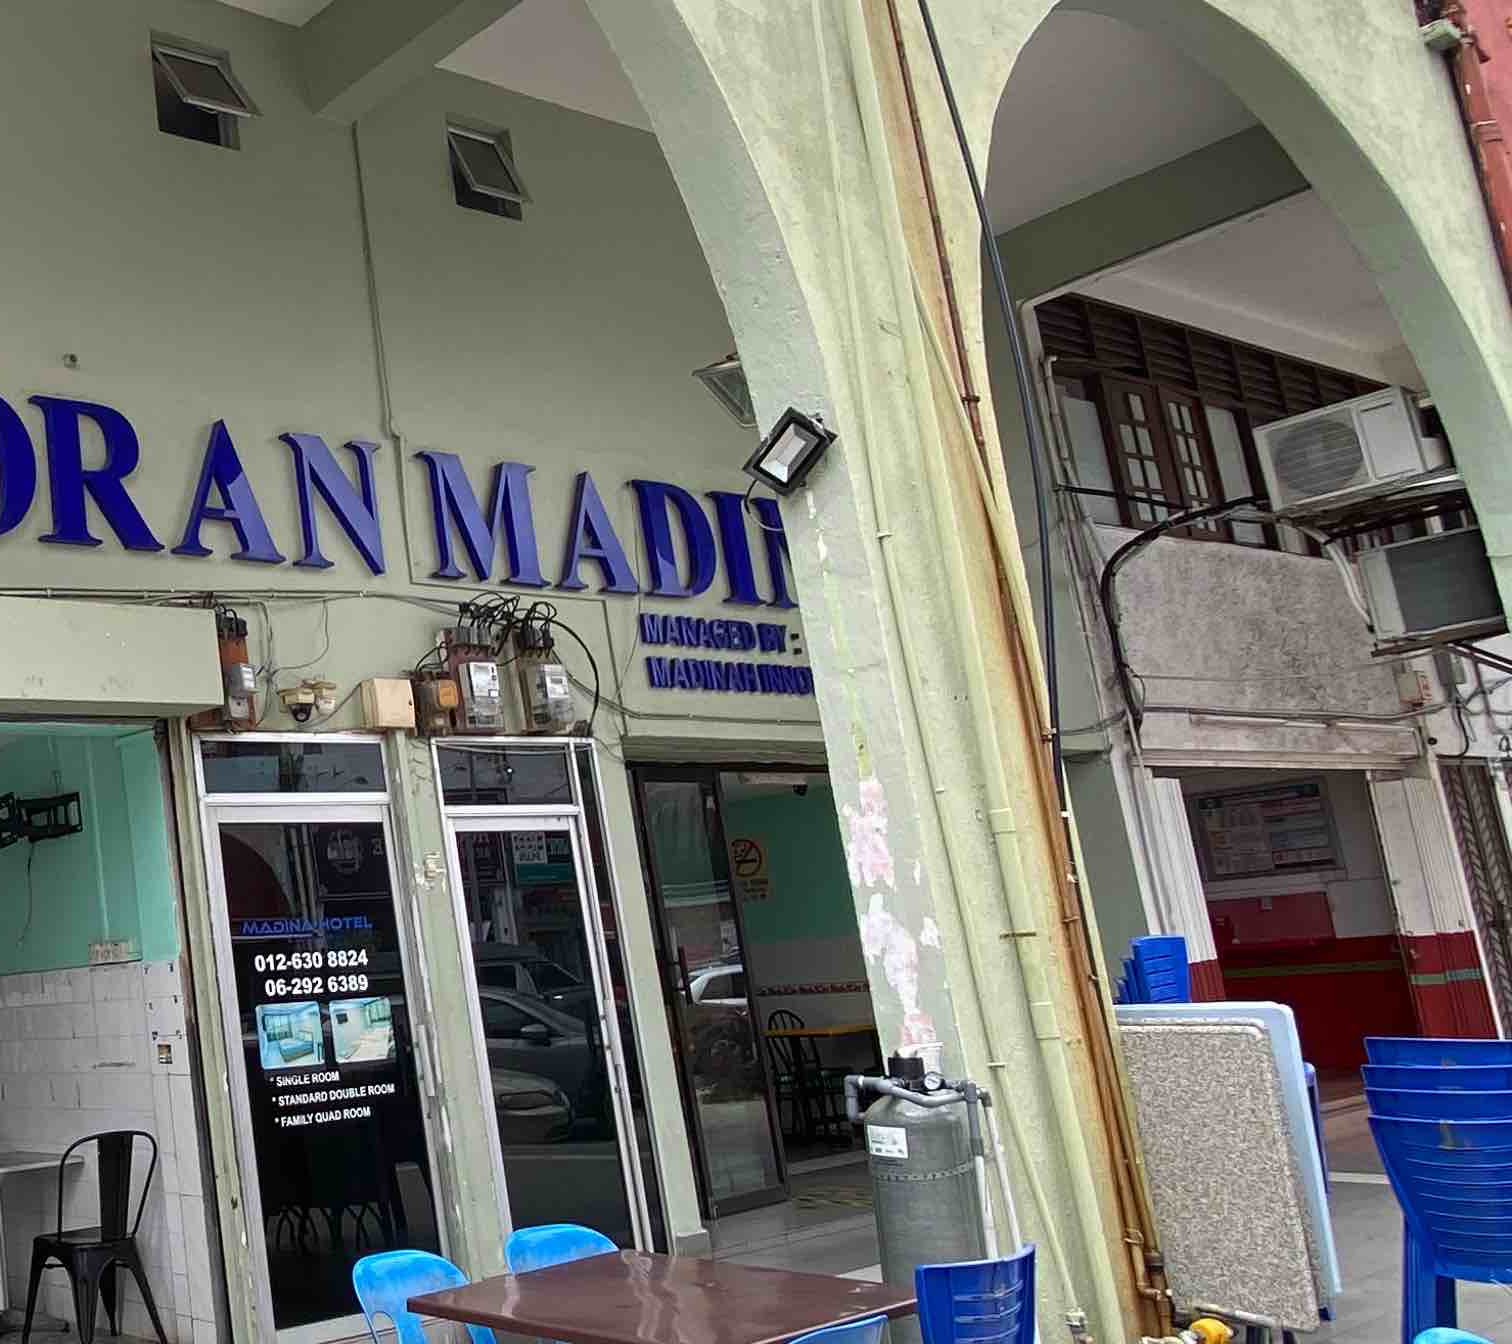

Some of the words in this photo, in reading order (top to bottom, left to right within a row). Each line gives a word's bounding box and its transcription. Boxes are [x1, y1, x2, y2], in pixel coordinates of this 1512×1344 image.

[640, 612, 756, 651] MANAGED
[645, 656, 758, 693] MADINAH
[242, 919, 313, 935] MADINA
[319, 914, 373, 930] HOTEL
[254, 951, 323, 972] 012-630
[327, 948, 369, 968] 8824
[264, 977, 324, 997] 06-292
[327, 974, 369, 993] 6389
[276, 1074, 311, 1087] SINGLE
[311, 1070, 341, 1084] ROOM
[278, 1090, 328, 1106] STANDARD
[328, 1085, 367, 1102] DOUBLE
[367, 1082, 396, 1097] ROOM
[280, 1113, 314, 1127] FAMILY
[314, 1109, 342, 1124] QUAD
[343, 1104, 372, 1120] ROOM
